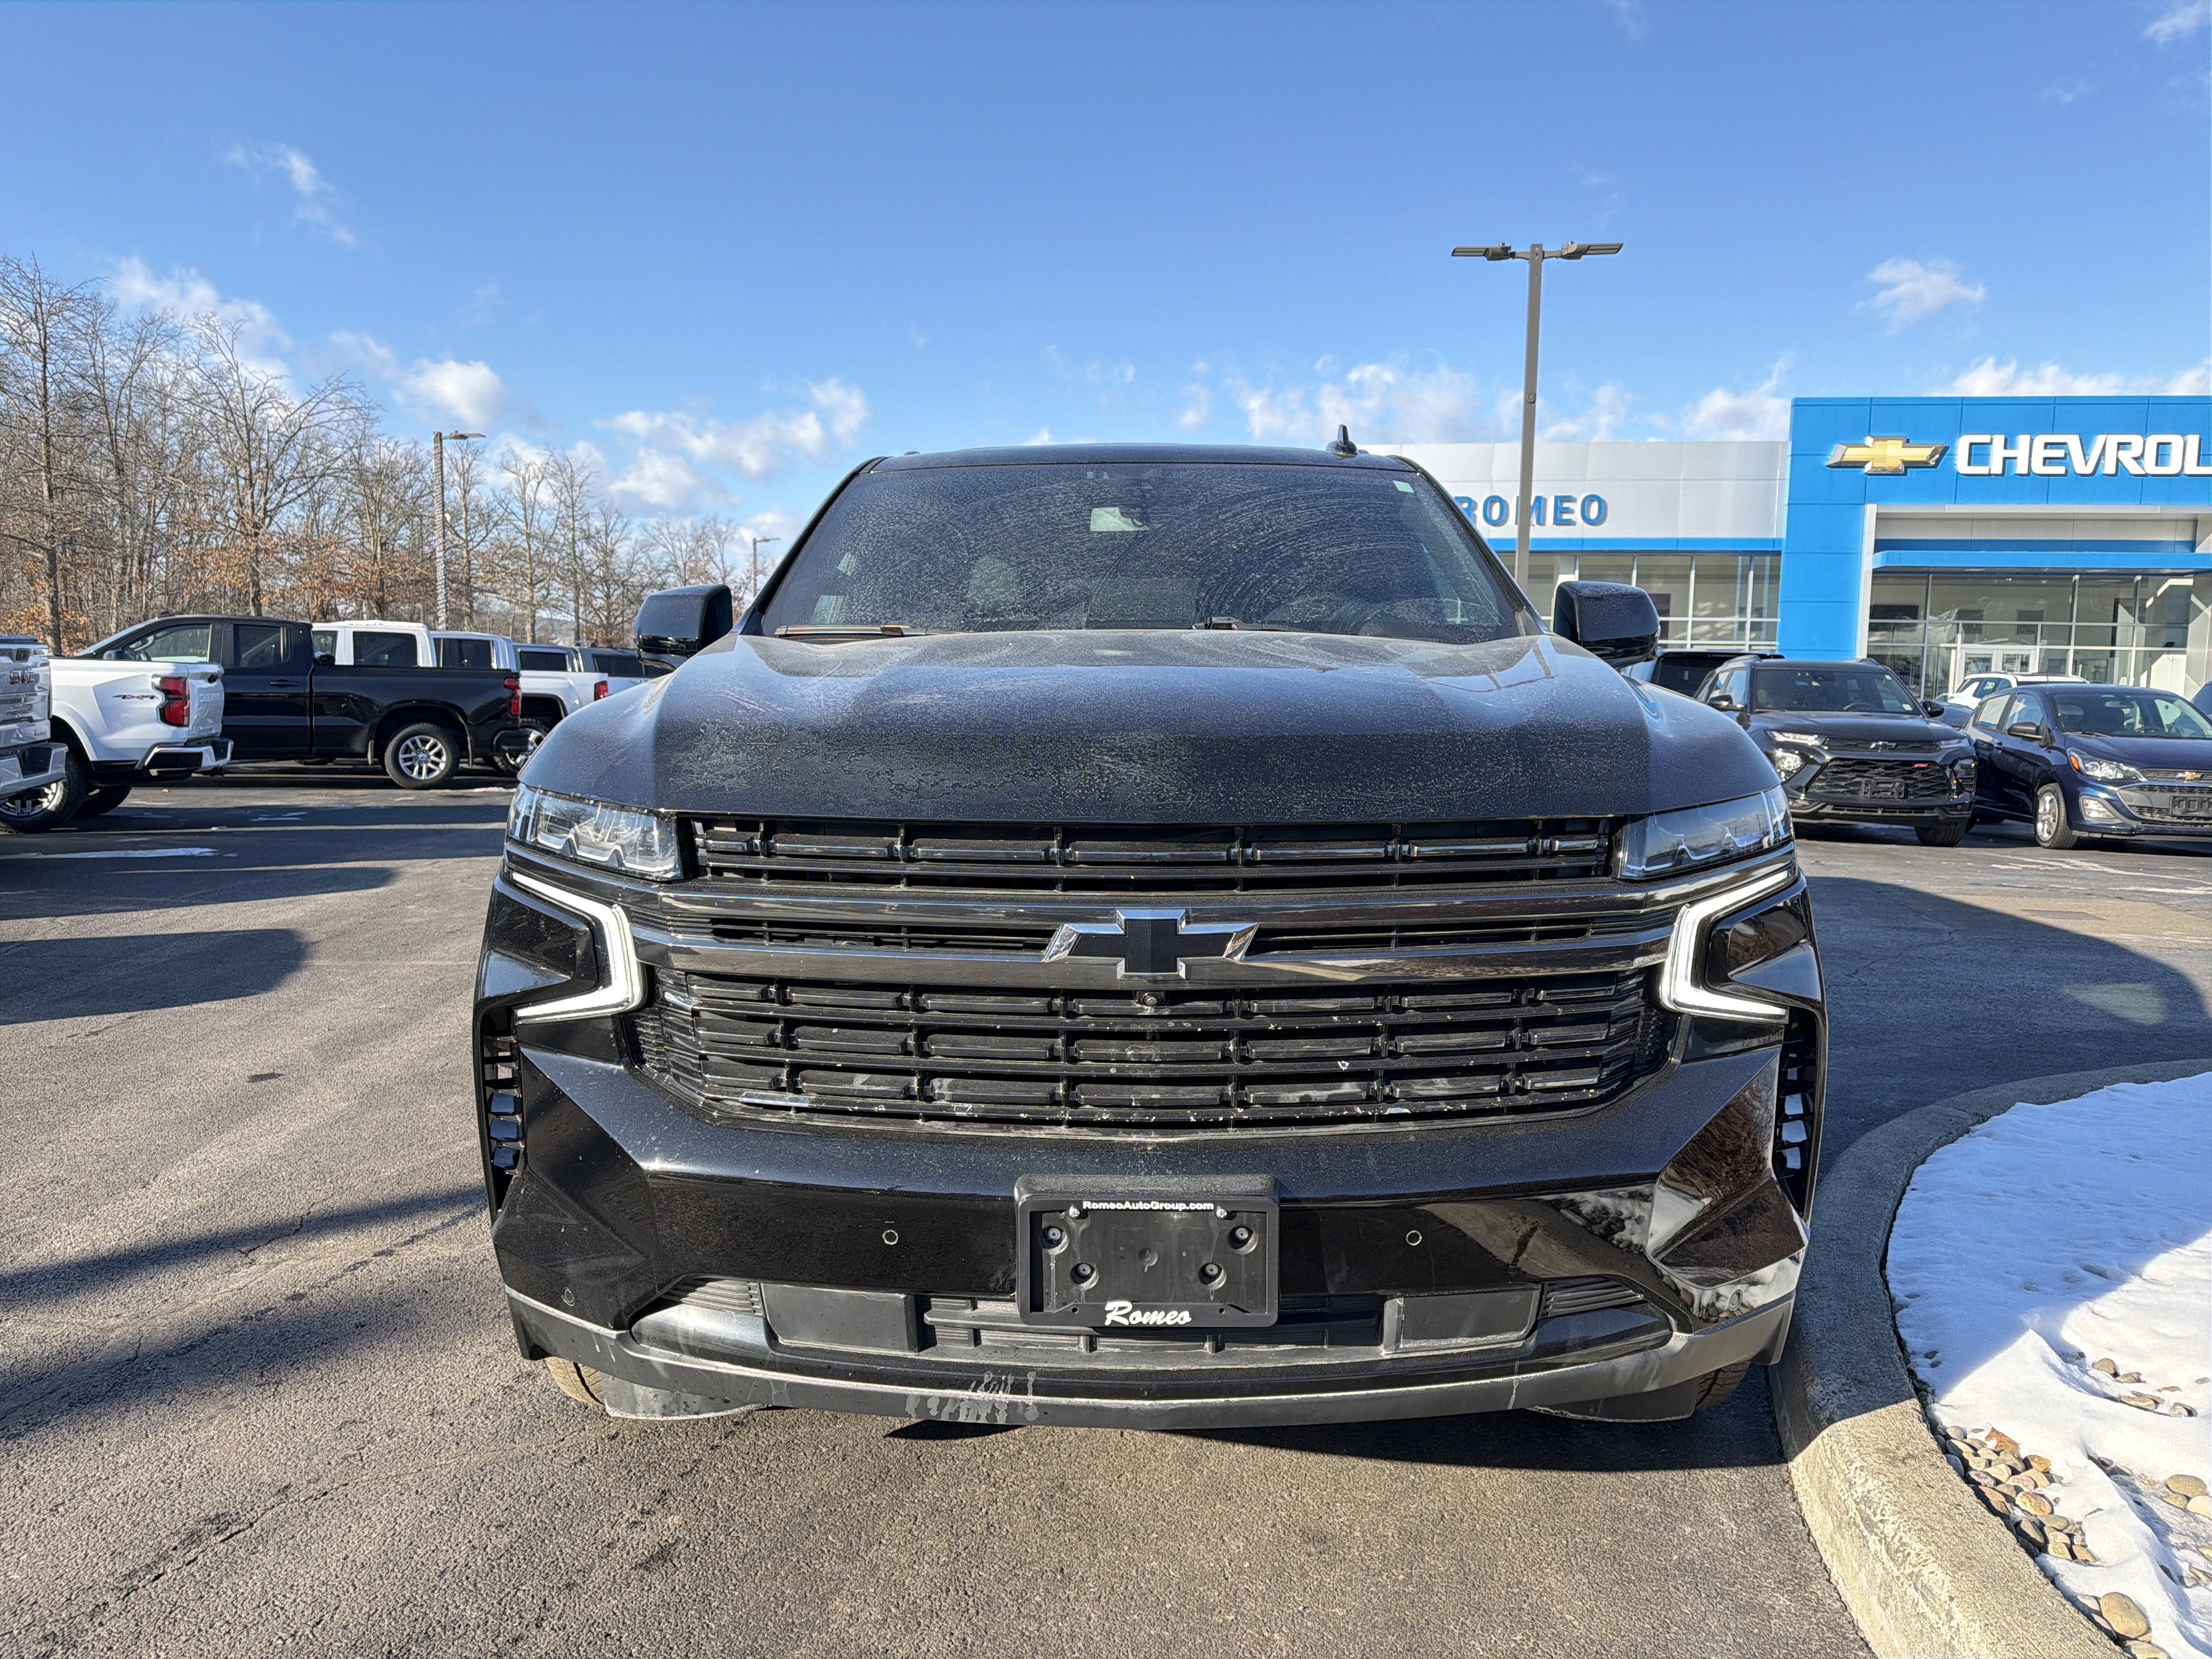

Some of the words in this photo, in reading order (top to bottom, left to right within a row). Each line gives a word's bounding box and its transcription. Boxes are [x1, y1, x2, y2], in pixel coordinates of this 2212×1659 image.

[1957, 435, 2212, 476] CHEVROL
[1082, 1200, 1214, 1211] RomeoAutoGroup.com
[1104, 1301, 1192, 1326] Romeo
